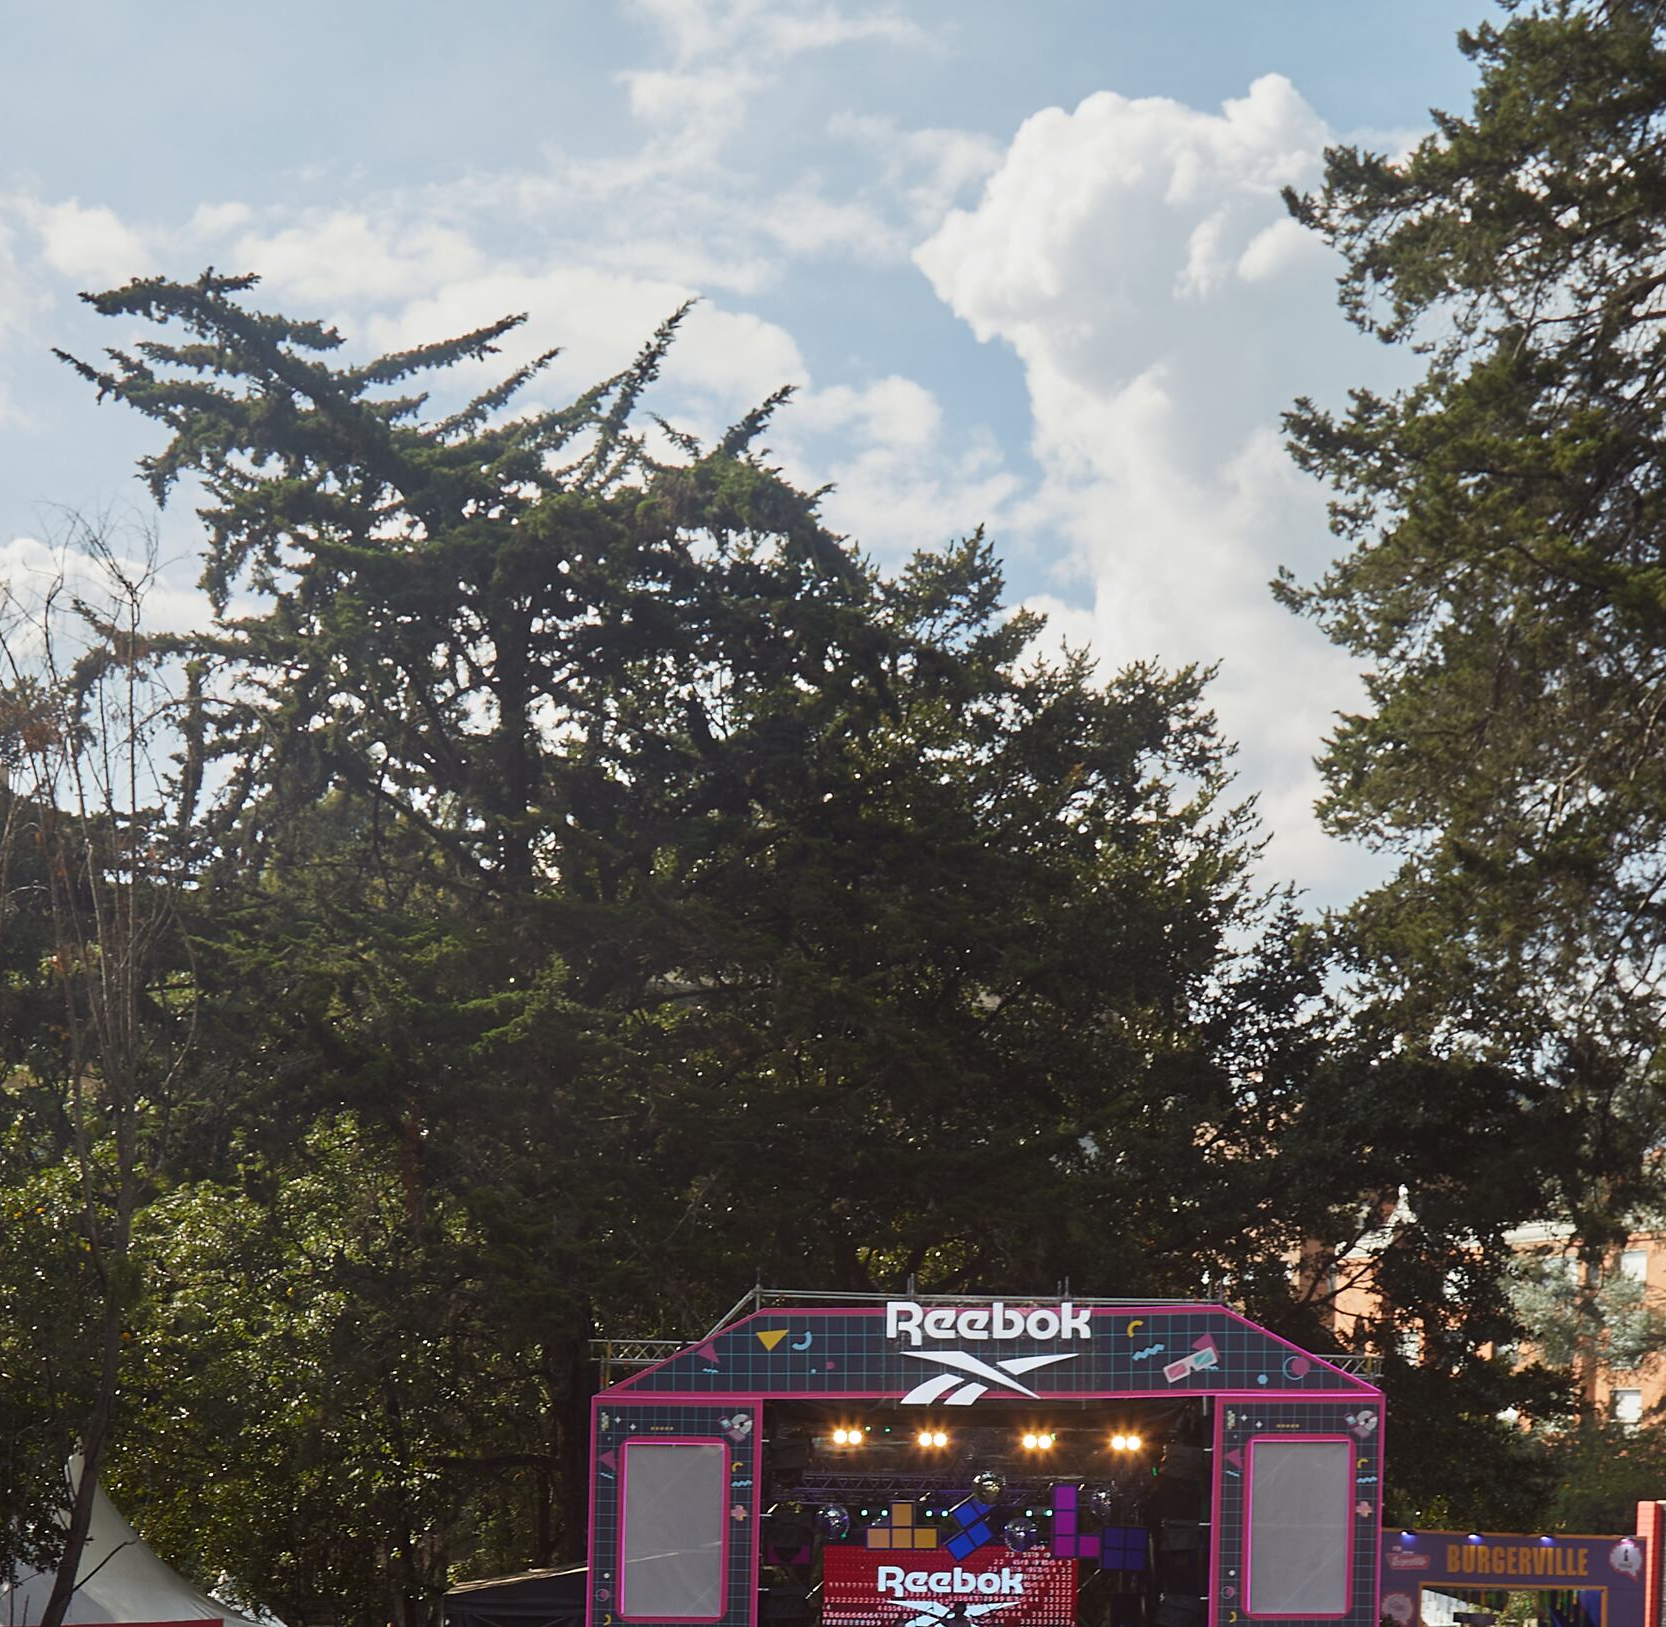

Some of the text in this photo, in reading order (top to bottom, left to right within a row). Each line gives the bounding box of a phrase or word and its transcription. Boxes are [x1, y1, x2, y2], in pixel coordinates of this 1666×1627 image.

[886, 1301, 1092, 1346] Reebok
[1446, 1544, 1590, 1577] BURGERVILLE
[877, 1565, 1026, 1598] Reebok
